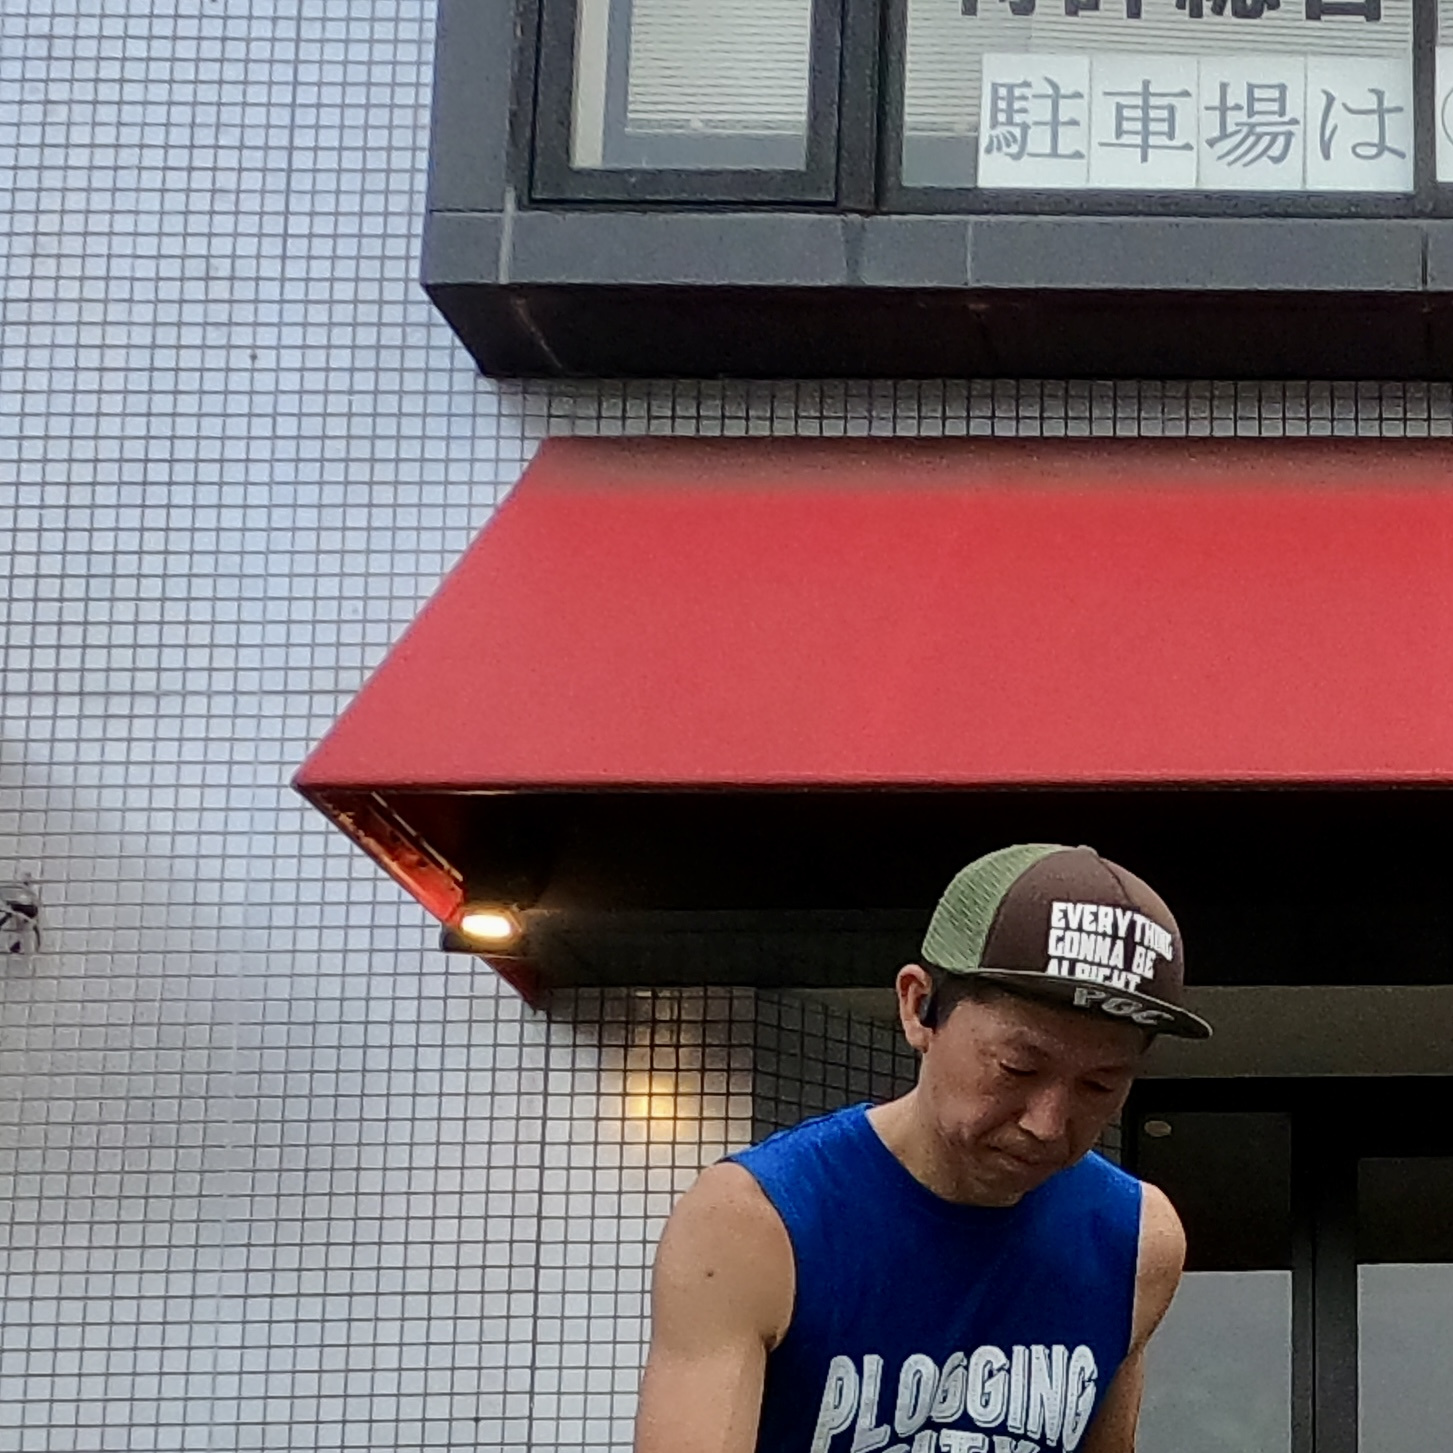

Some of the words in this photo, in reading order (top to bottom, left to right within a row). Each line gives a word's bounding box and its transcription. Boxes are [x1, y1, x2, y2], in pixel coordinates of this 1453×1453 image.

[983, 77, 1407, 168] 駐車場は
[1048, 928, 1124, 969] GONNA
[1132, 944, 1156, 980] BE
[1051, 901, 1174, 961] EVERYTHING
